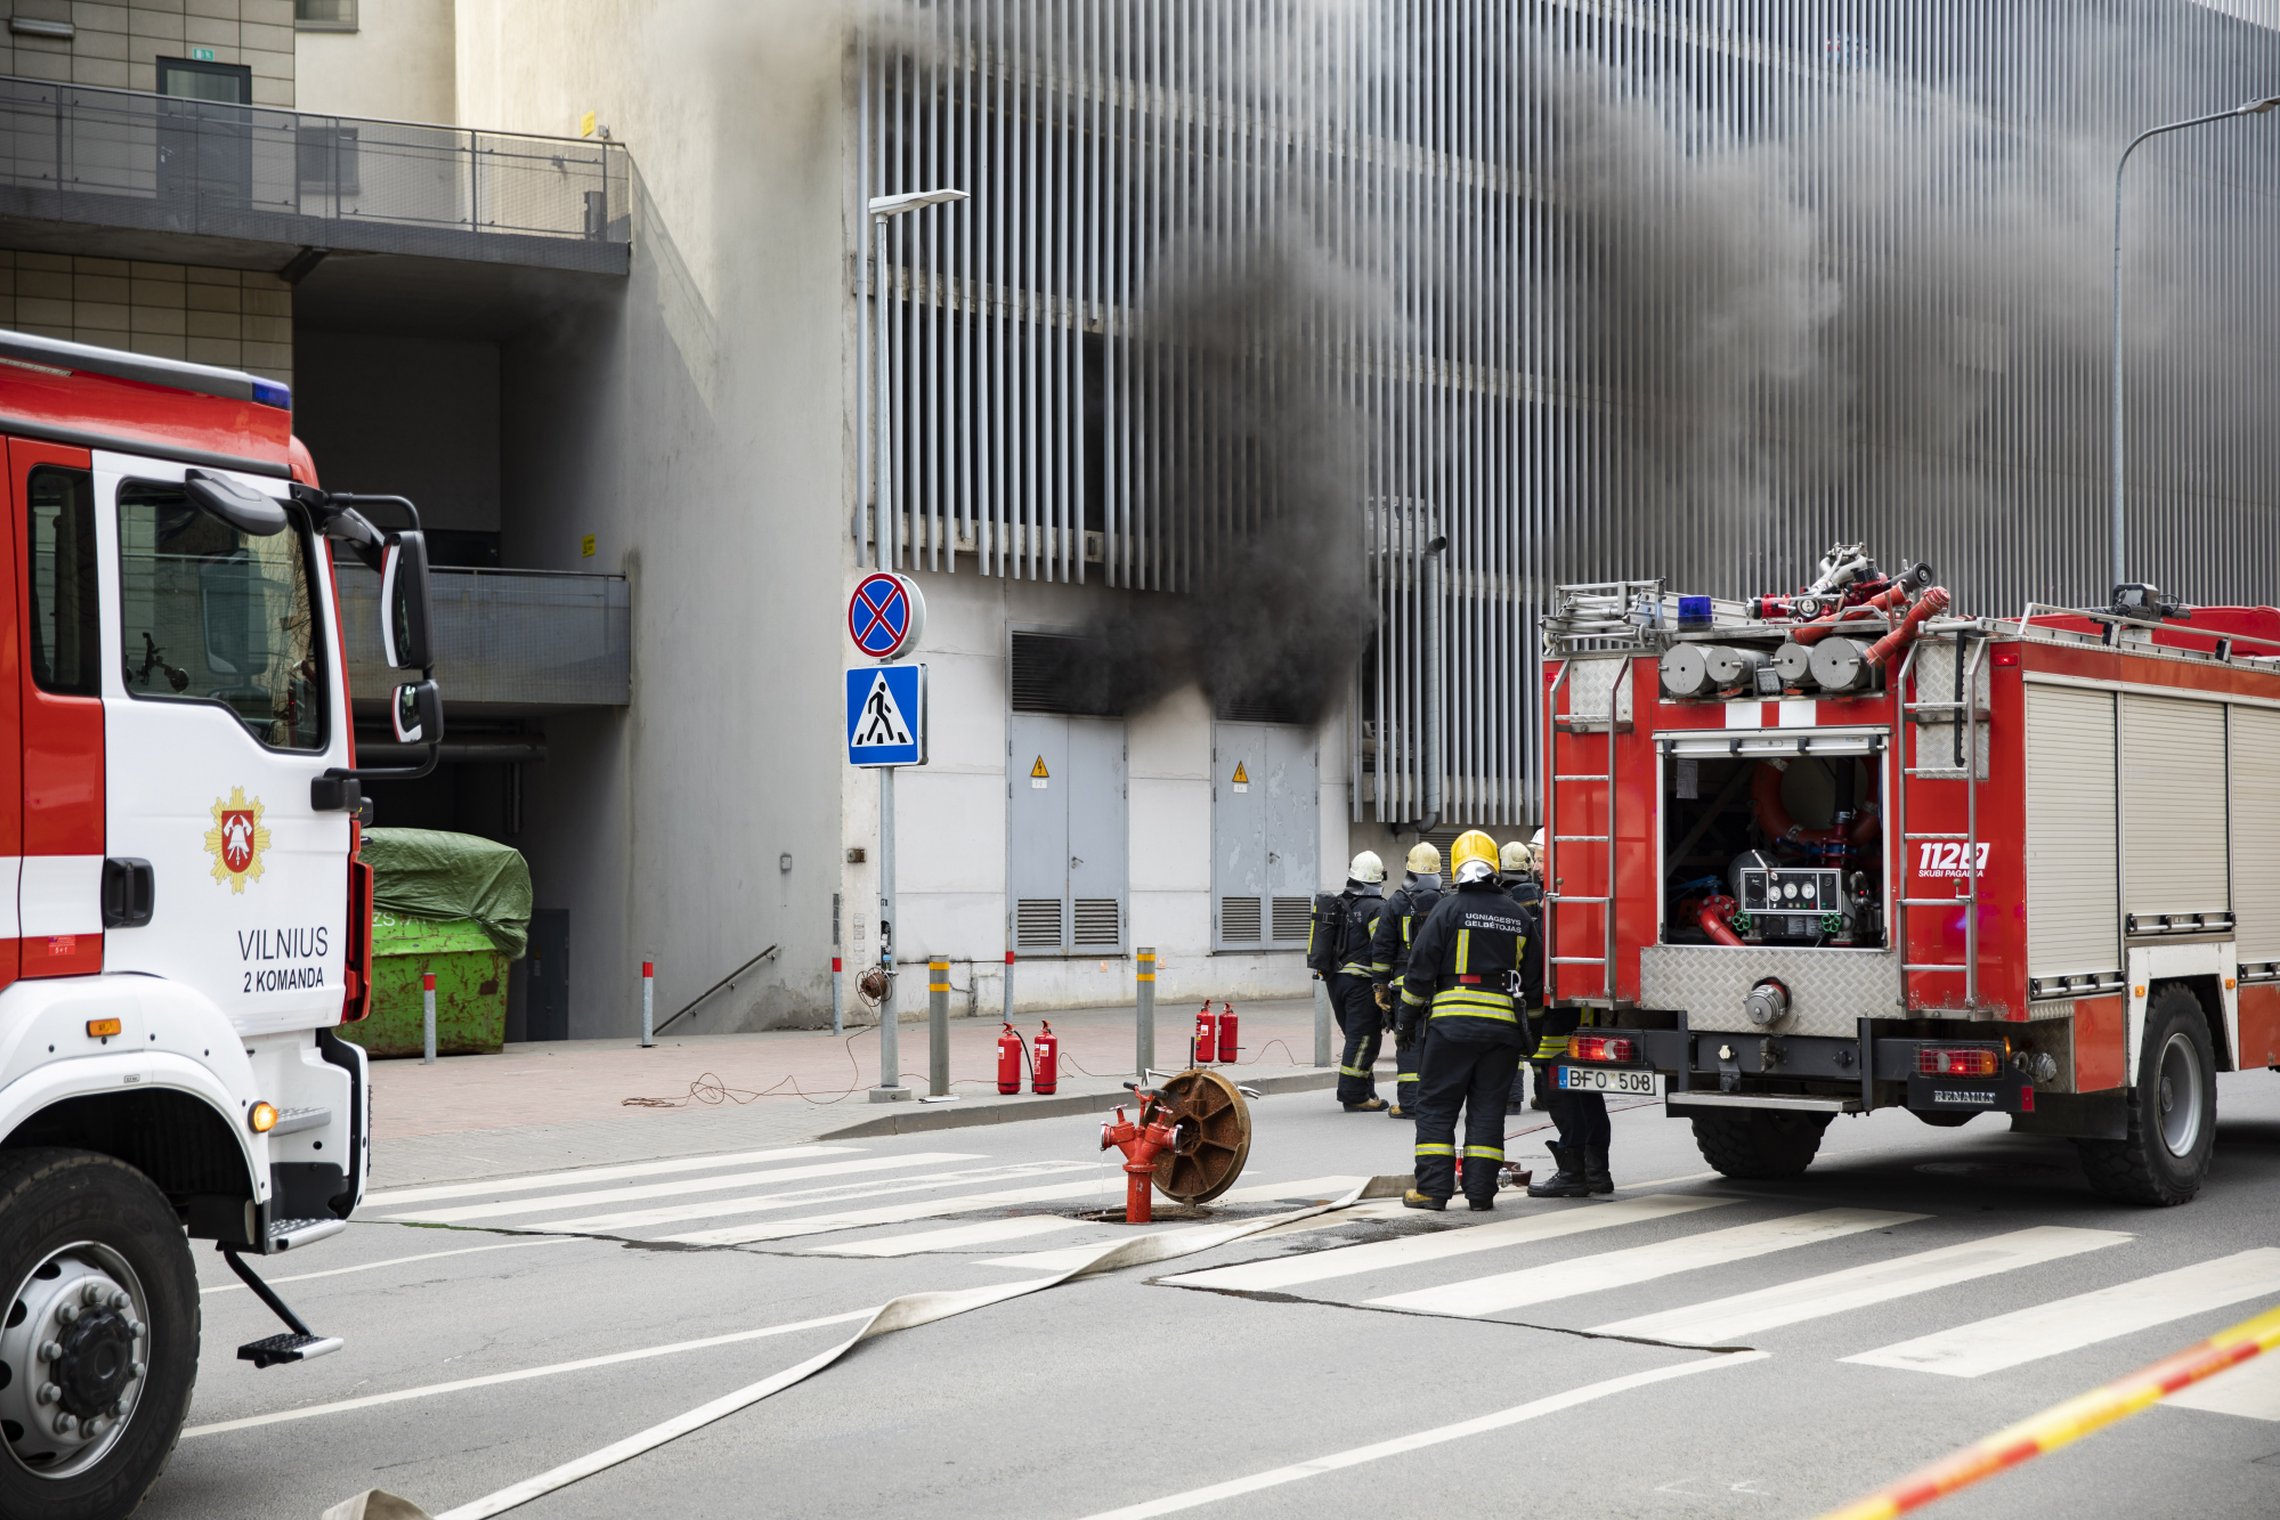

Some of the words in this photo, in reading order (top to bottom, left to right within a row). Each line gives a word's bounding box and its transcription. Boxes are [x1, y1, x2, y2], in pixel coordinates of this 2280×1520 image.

[1919, 842, 1962, 870] 112
[1918, 869, 1944, 878] SKUBI
[1945, 870, 1984, 878] PAGALA
[1465, 912, 1522, 926] UGNIAGESYS
[237, 926, 328, 961] VILNIUS
[243, 971, 252, 993] 2
[256, 966, 324, 992] KOMANDA
[1569, 1069, 1607, 1089] BFO
[1618, 1072, 1651, 1092] 508
[1934, 1090, 1996, 1104] RENAULT
